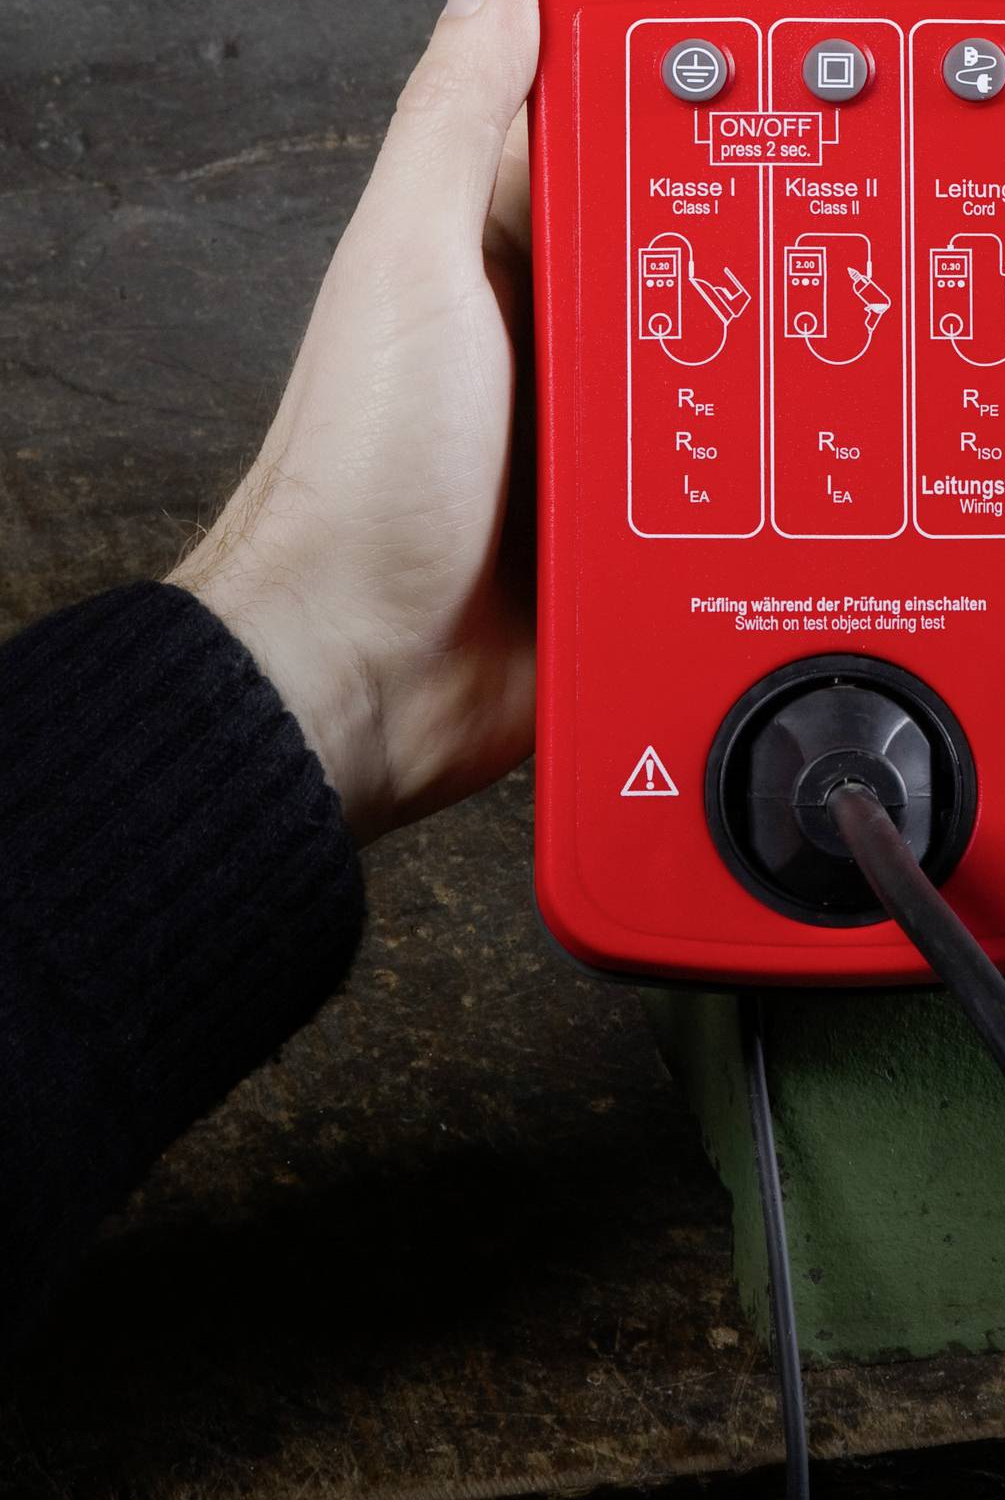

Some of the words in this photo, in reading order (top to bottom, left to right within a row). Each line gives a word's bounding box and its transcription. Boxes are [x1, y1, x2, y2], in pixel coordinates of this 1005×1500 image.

[720, 118, 811, 137] ON/OFF
[721, 145, 761, 159] press
[767, 141, 775, 156] 2
[781, 145, 810, 156] sec.
[650, 178, 722, 196] Klasse
[730, 178, 735, 196] I
[786, 178, 858, 196] Klasse
[866, 179, 878, 196] II
[673, 200, 710, 214] Class
[714, 200, 719, 214] I
[810, 200, 847, 214] Class
[851, 201, 860, 214] II
[963, 201, 995, 215] Cord
[651, 262, 669, 270] 0.20
[679, 389, 714, 415] RPE
[964, 389, 998, 416] RPE
[676, 432, 717, 459] RISO
[819, 432, 860, 459] RISO
[961, 432, 1002, 459] RISO
[685, 475, 709, 502] IEA
[828, 475, 852, 503] IEA
[960, 499, 1002, 516] Wiring
[691, 597, 747, 615] Prüfling
[751, 597, 812, 612] während
[817, 597, 840, 611] der
[844, 597, 900, 614] Prüfung
[905, 596, 986, 611] einschalten
[736, 616, 778, 630] Switch
[783, 619, 799, 630] on
[803, 616, 828, 630] test
[832, 615, 871, 633] object
[875, 615, 916, 633] during
[921, 615, 945, 629] test
